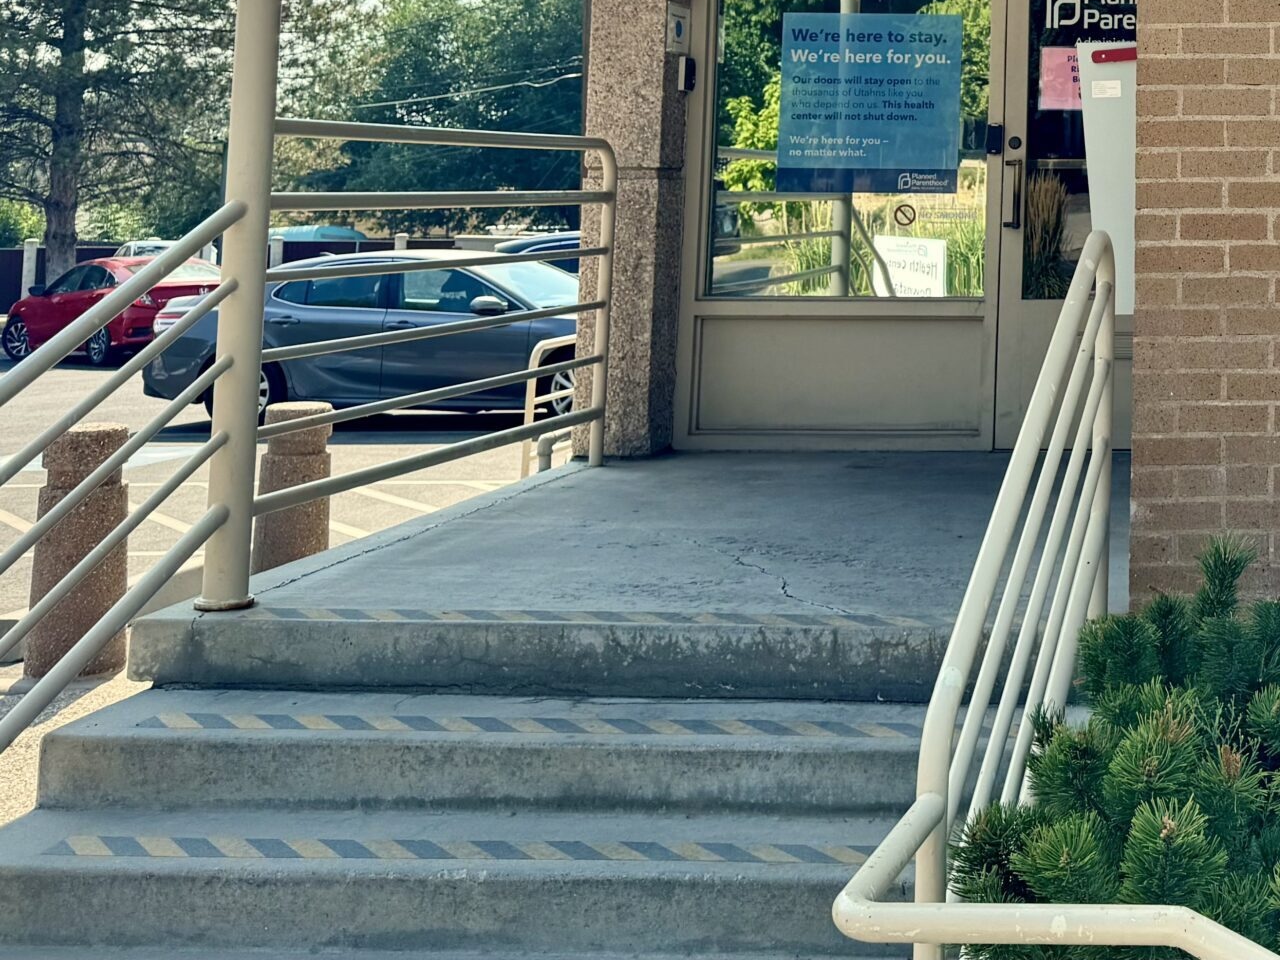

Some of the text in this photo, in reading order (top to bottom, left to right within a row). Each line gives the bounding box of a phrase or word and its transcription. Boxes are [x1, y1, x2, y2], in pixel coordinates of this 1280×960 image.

[792, 28, 947, 47] We're here to stay.
[791, 49, 951, 68] We're here for you.
[792, 76, 940, 87] Our doors will stay open to the
[792, 88, 923, 99] thousands of Utahns like you
[881, 100, 901, 109] This
[904, 100, 935, 109] health
[791, 112, 917, 121] center will not shut down.
[790, 136, 818, 144] We're
[821, 136, 843, 145] here
[846, 136, 860, 145] for
[862, 138, 880, 147] you
[804, 149, 837, 157] matter
[839, 148, 866, 157] what.
